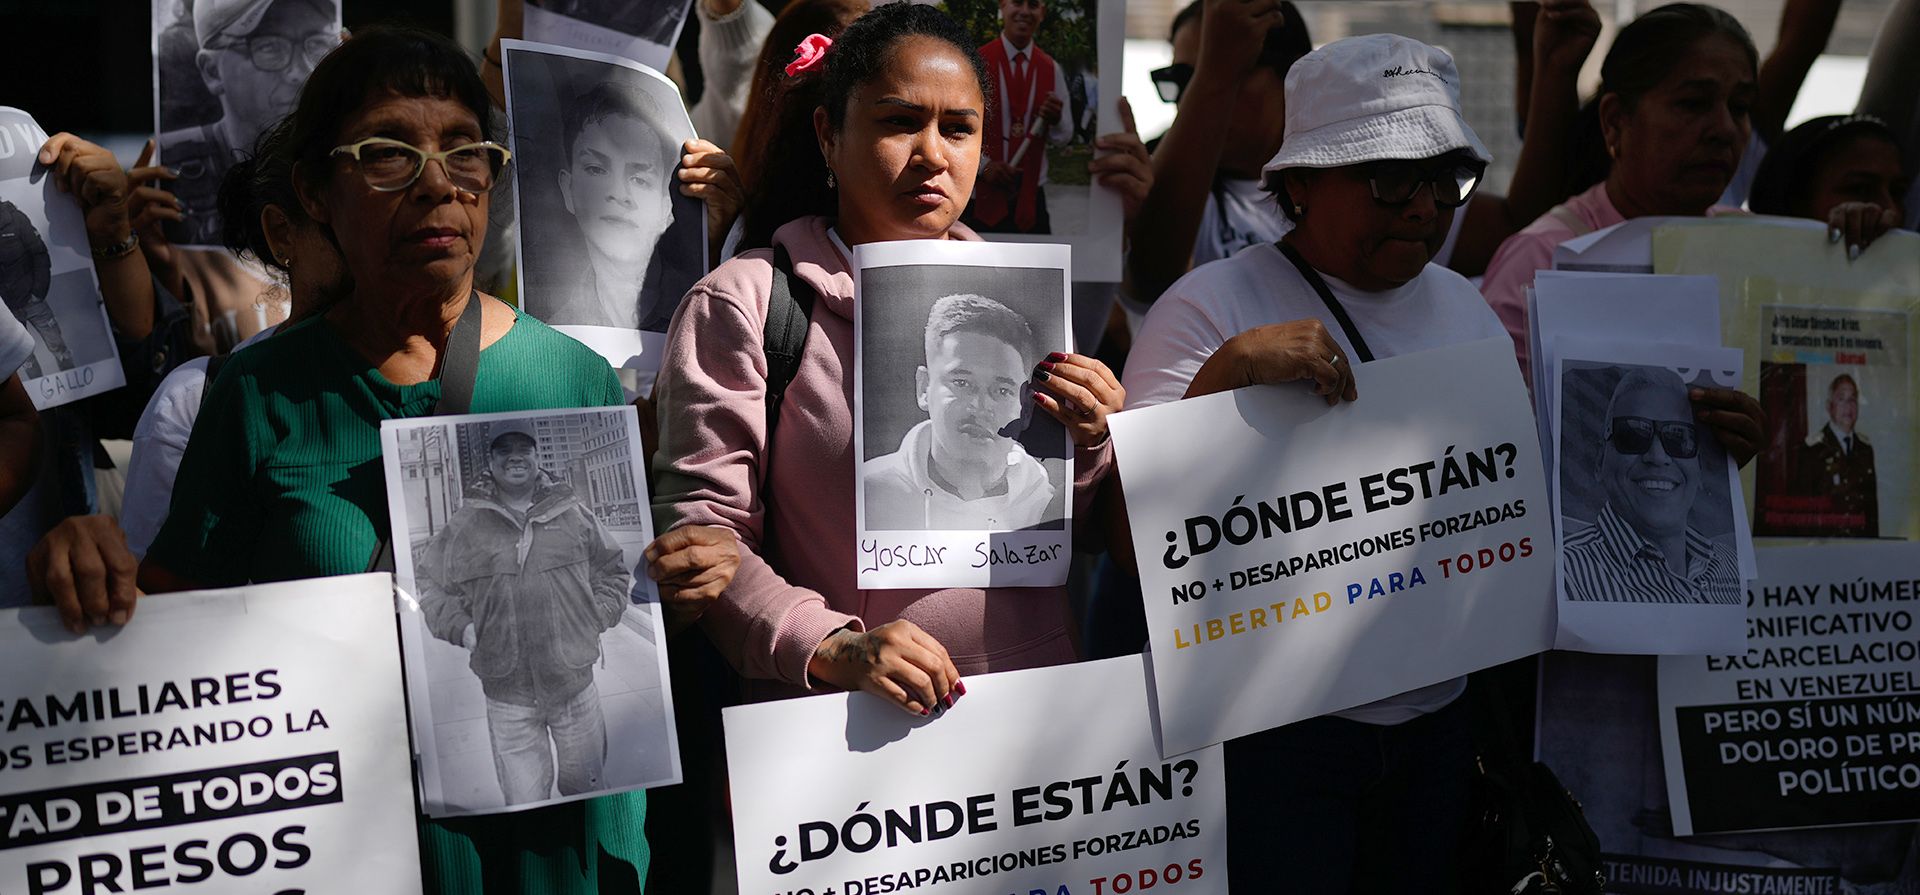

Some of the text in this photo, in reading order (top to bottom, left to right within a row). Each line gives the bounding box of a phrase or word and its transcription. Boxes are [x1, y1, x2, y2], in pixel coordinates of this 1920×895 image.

[40, 367, 94, 399] GALLO
[1163, 442, 1518, 570] ¿DÓNDE ESTÁN?
[971, 542, 1062, 568] Salazar
[1171, 580, 1207, 606] NO
[1230, 527, 1416, 592] DESAPARICIONES
[1419, 499, 1527, 543] FORZADAS
[1174, 536, 1534, 650] LIBERTAD PARA TODOS
[1764, 584, 1821, 607] HAY
[1747, 610, 1913, 639] NIFICATIVO
[1706, 640, 1920, 671] EXCARCELACIO
[0, 669, 282, 732] AMILIARES
[1737, 671, 1920, 700] EN VENEZUEL
[1703, 708, 1781, 734] PERO
[1789, 701, 1812, 729] SÍ
[1819, 704, 1859, 727] UN
[45, 716, 273, 765] ESPERANDO
[285, 709, 329, 734] LA
[1719, 736, 1838, 764] DOLORO
[1845, 733, 1883, 757] DE
[1778, 761, 1920, 796] POLÍTICO
[0, 762, 337, 838] AD DE TODOS
[769, 759, 1199, 875] ¿DÓNDE ESTÁN?
[26, 825, 311, 895] PRESOS
[844, 845, 1067, 895] DESAPARICIONES
[1073, 819, 1200, 860] FORZADAS
[1090, 858, 1204, 895] TODOS
[1601, 859, 1834, 895] TENIDA INJUSTAMENTE
